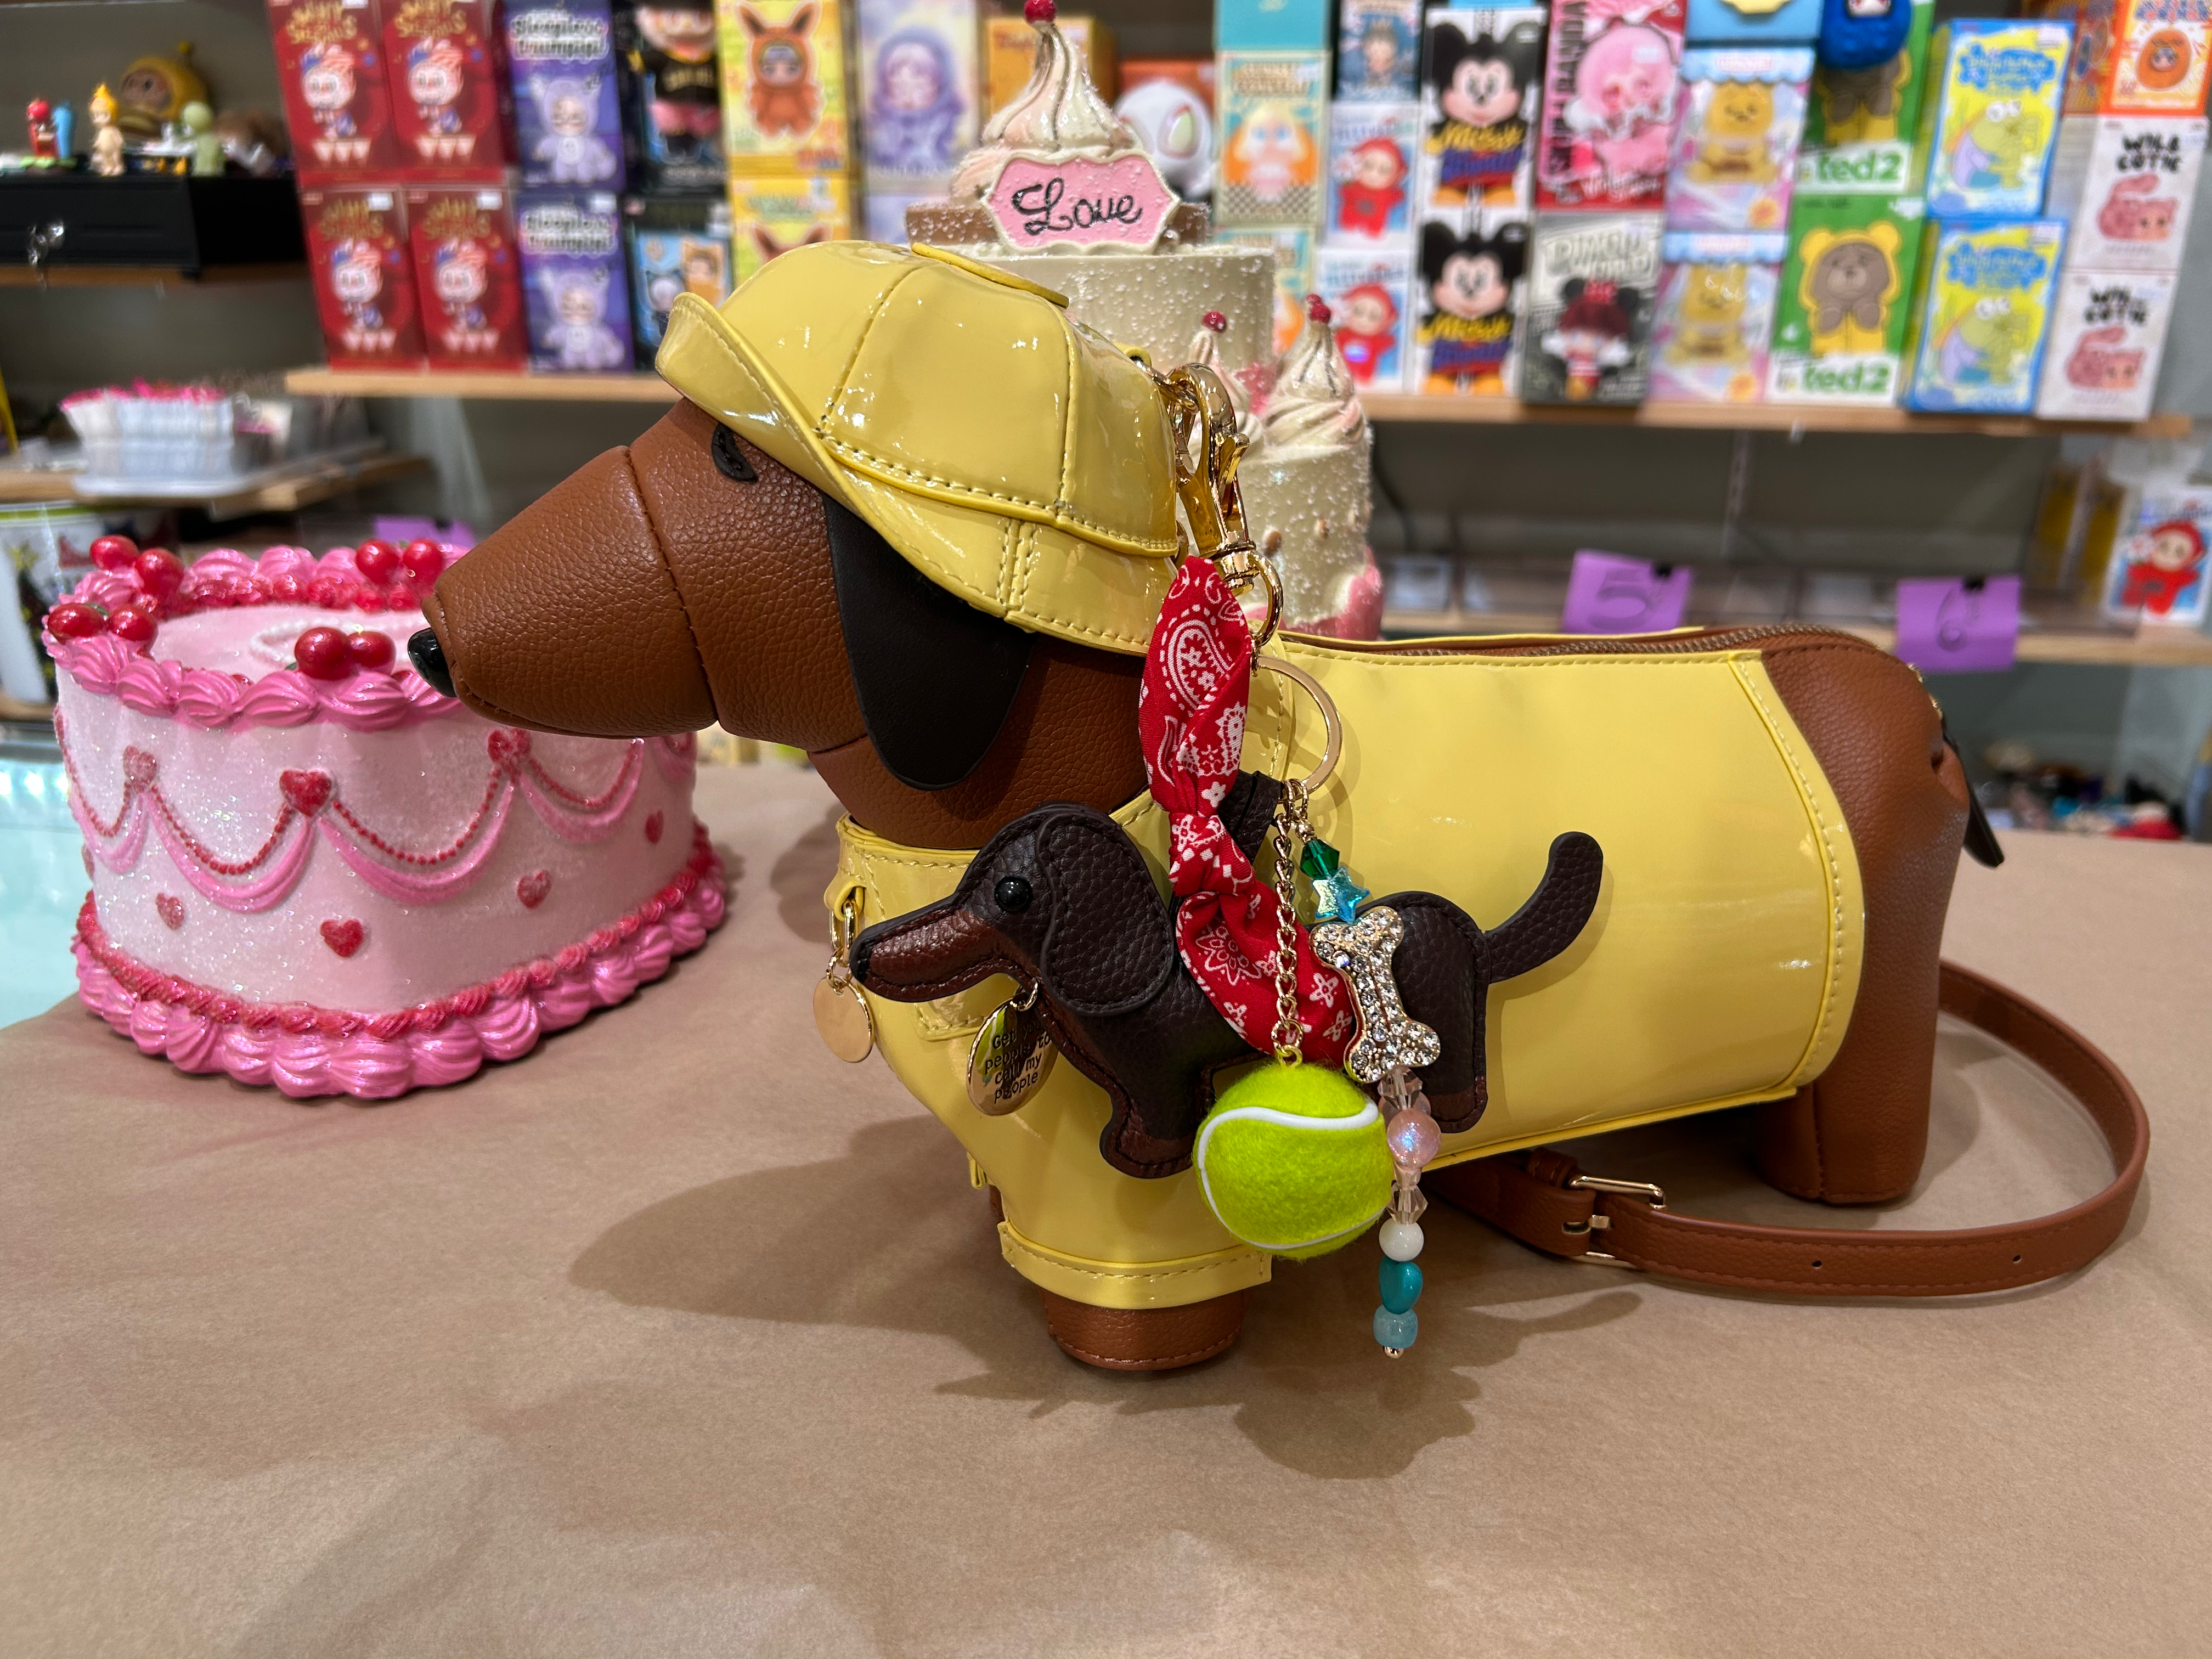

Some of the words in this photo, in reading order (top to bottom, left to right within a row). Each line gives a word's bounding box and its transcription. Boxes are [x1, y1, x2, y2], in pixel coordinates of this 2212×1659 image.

[1012, 177, 1143, 236] Love
[1587, 567, 1652, 631] 5
[1935, 588, 1971, 652] 6
[985, 1042, 1031, 1075] people
[1036, 1033, 1051, 1048] to
[992, 1029, 1017, 1049] Get
[1023, 1019, 1042, 1040] you
[994, 1071, 1039, 1104] people
[995, 1062, 1020, 1084] call
[1025, 1053, 1041, 1071] my
